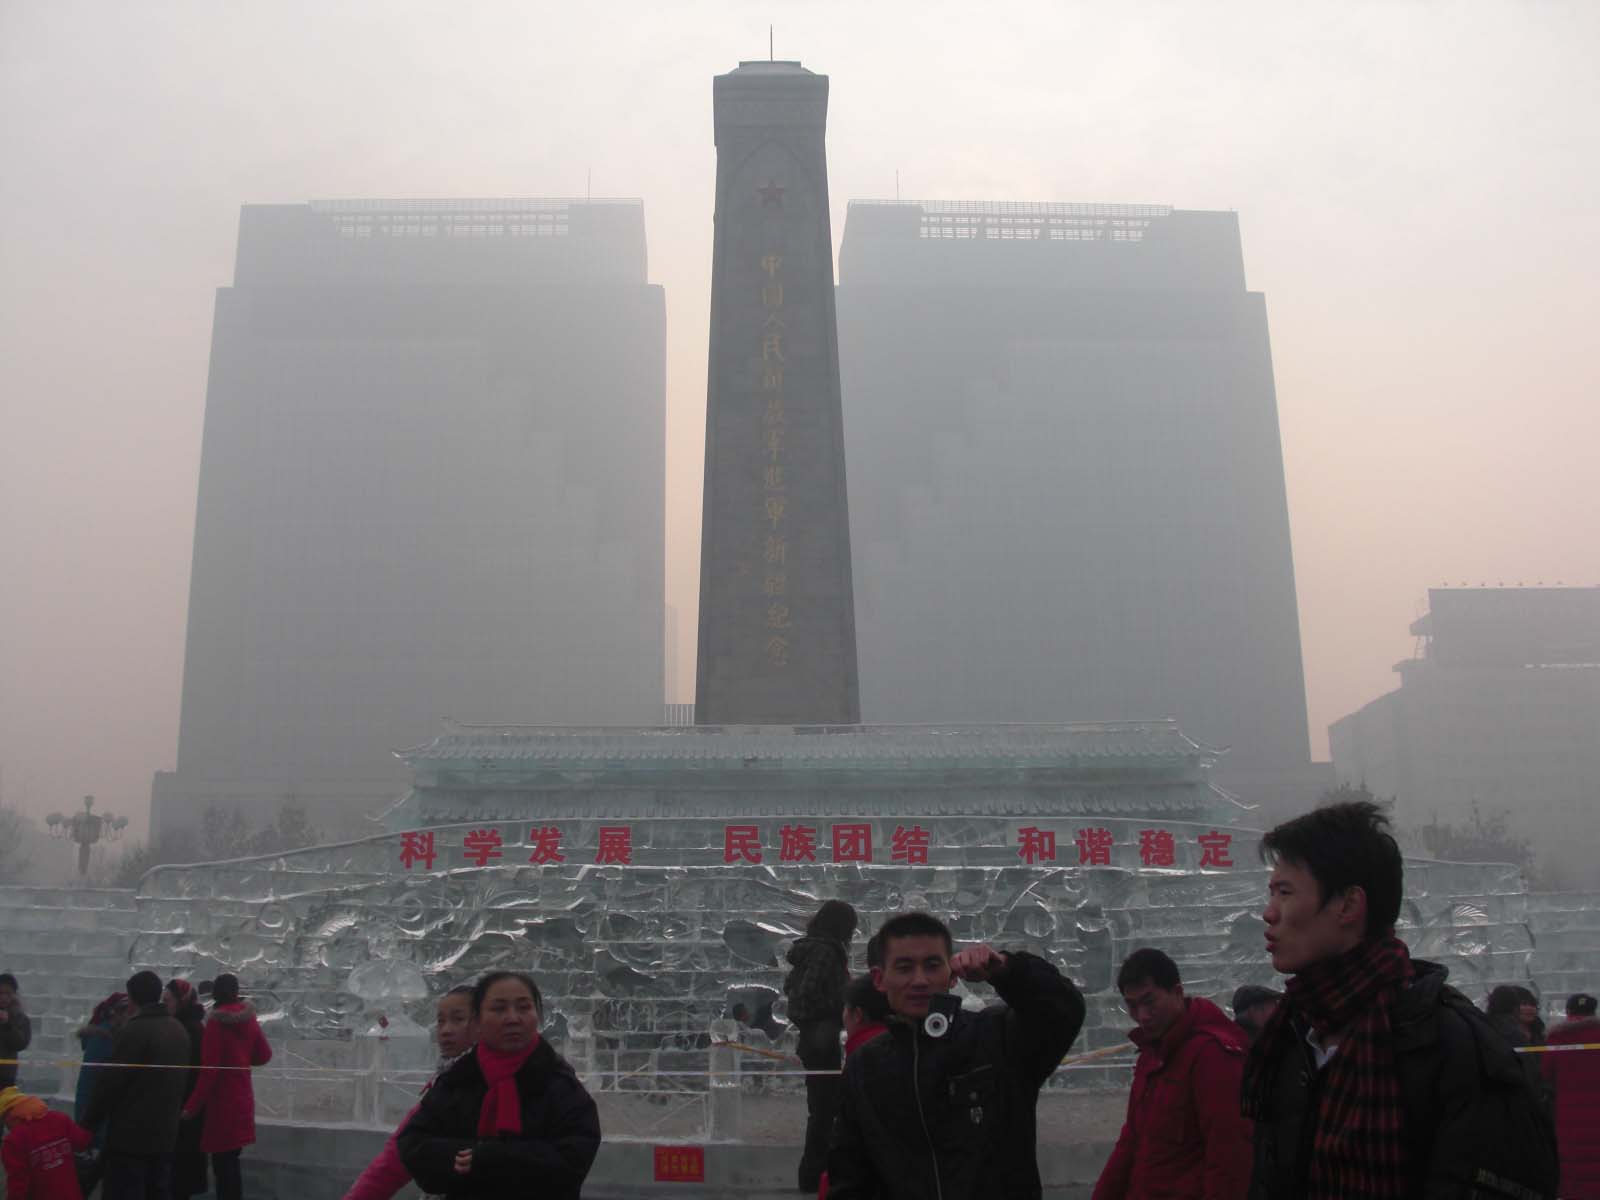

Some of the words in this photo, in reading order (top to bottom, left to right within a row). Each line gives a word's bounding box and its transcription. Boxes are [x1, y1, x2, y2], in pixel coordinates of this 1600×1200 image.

[399, 825, 632, 870] 科学发展
[723, 823, 930, 865] 民族团结
[1018, 826, 1234, 868] 和谐稳定
